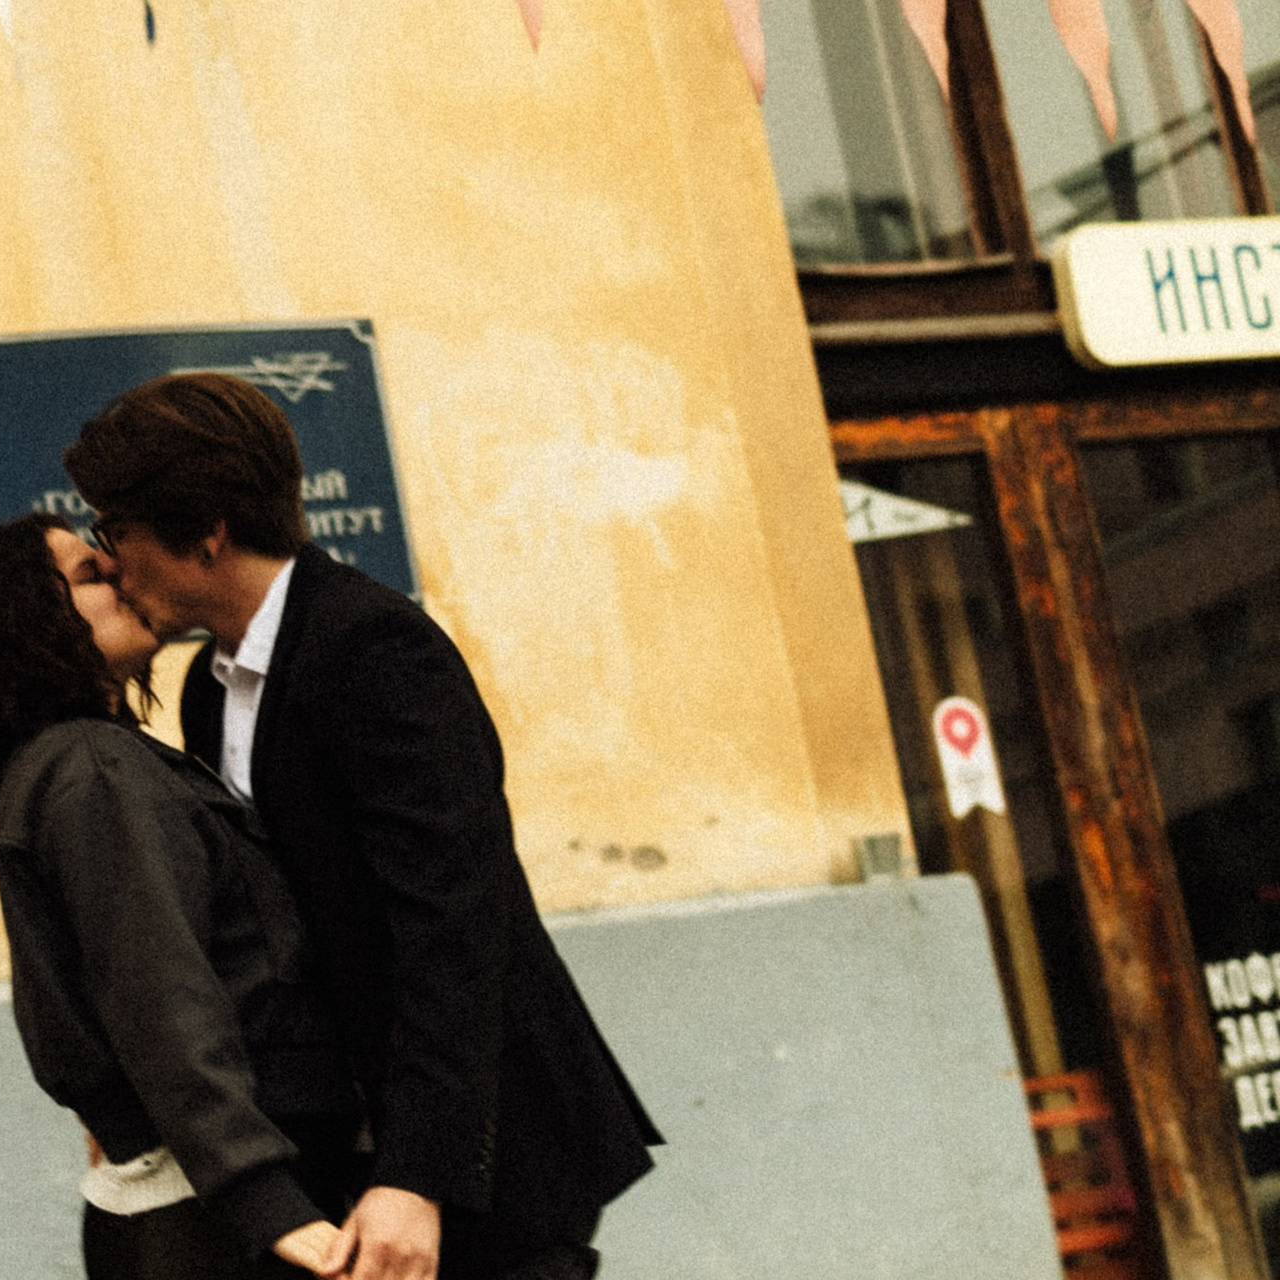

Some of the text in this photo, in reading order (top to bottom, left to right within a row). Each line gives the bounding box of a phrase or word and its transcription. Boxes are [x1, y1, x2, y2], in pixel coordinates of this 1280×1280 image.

[1144, 243, 1280, 334] ИНС
[307, 507, 383, 537] ИТУТ
[1219, 1009, 1280, 1068] ЗАВ
